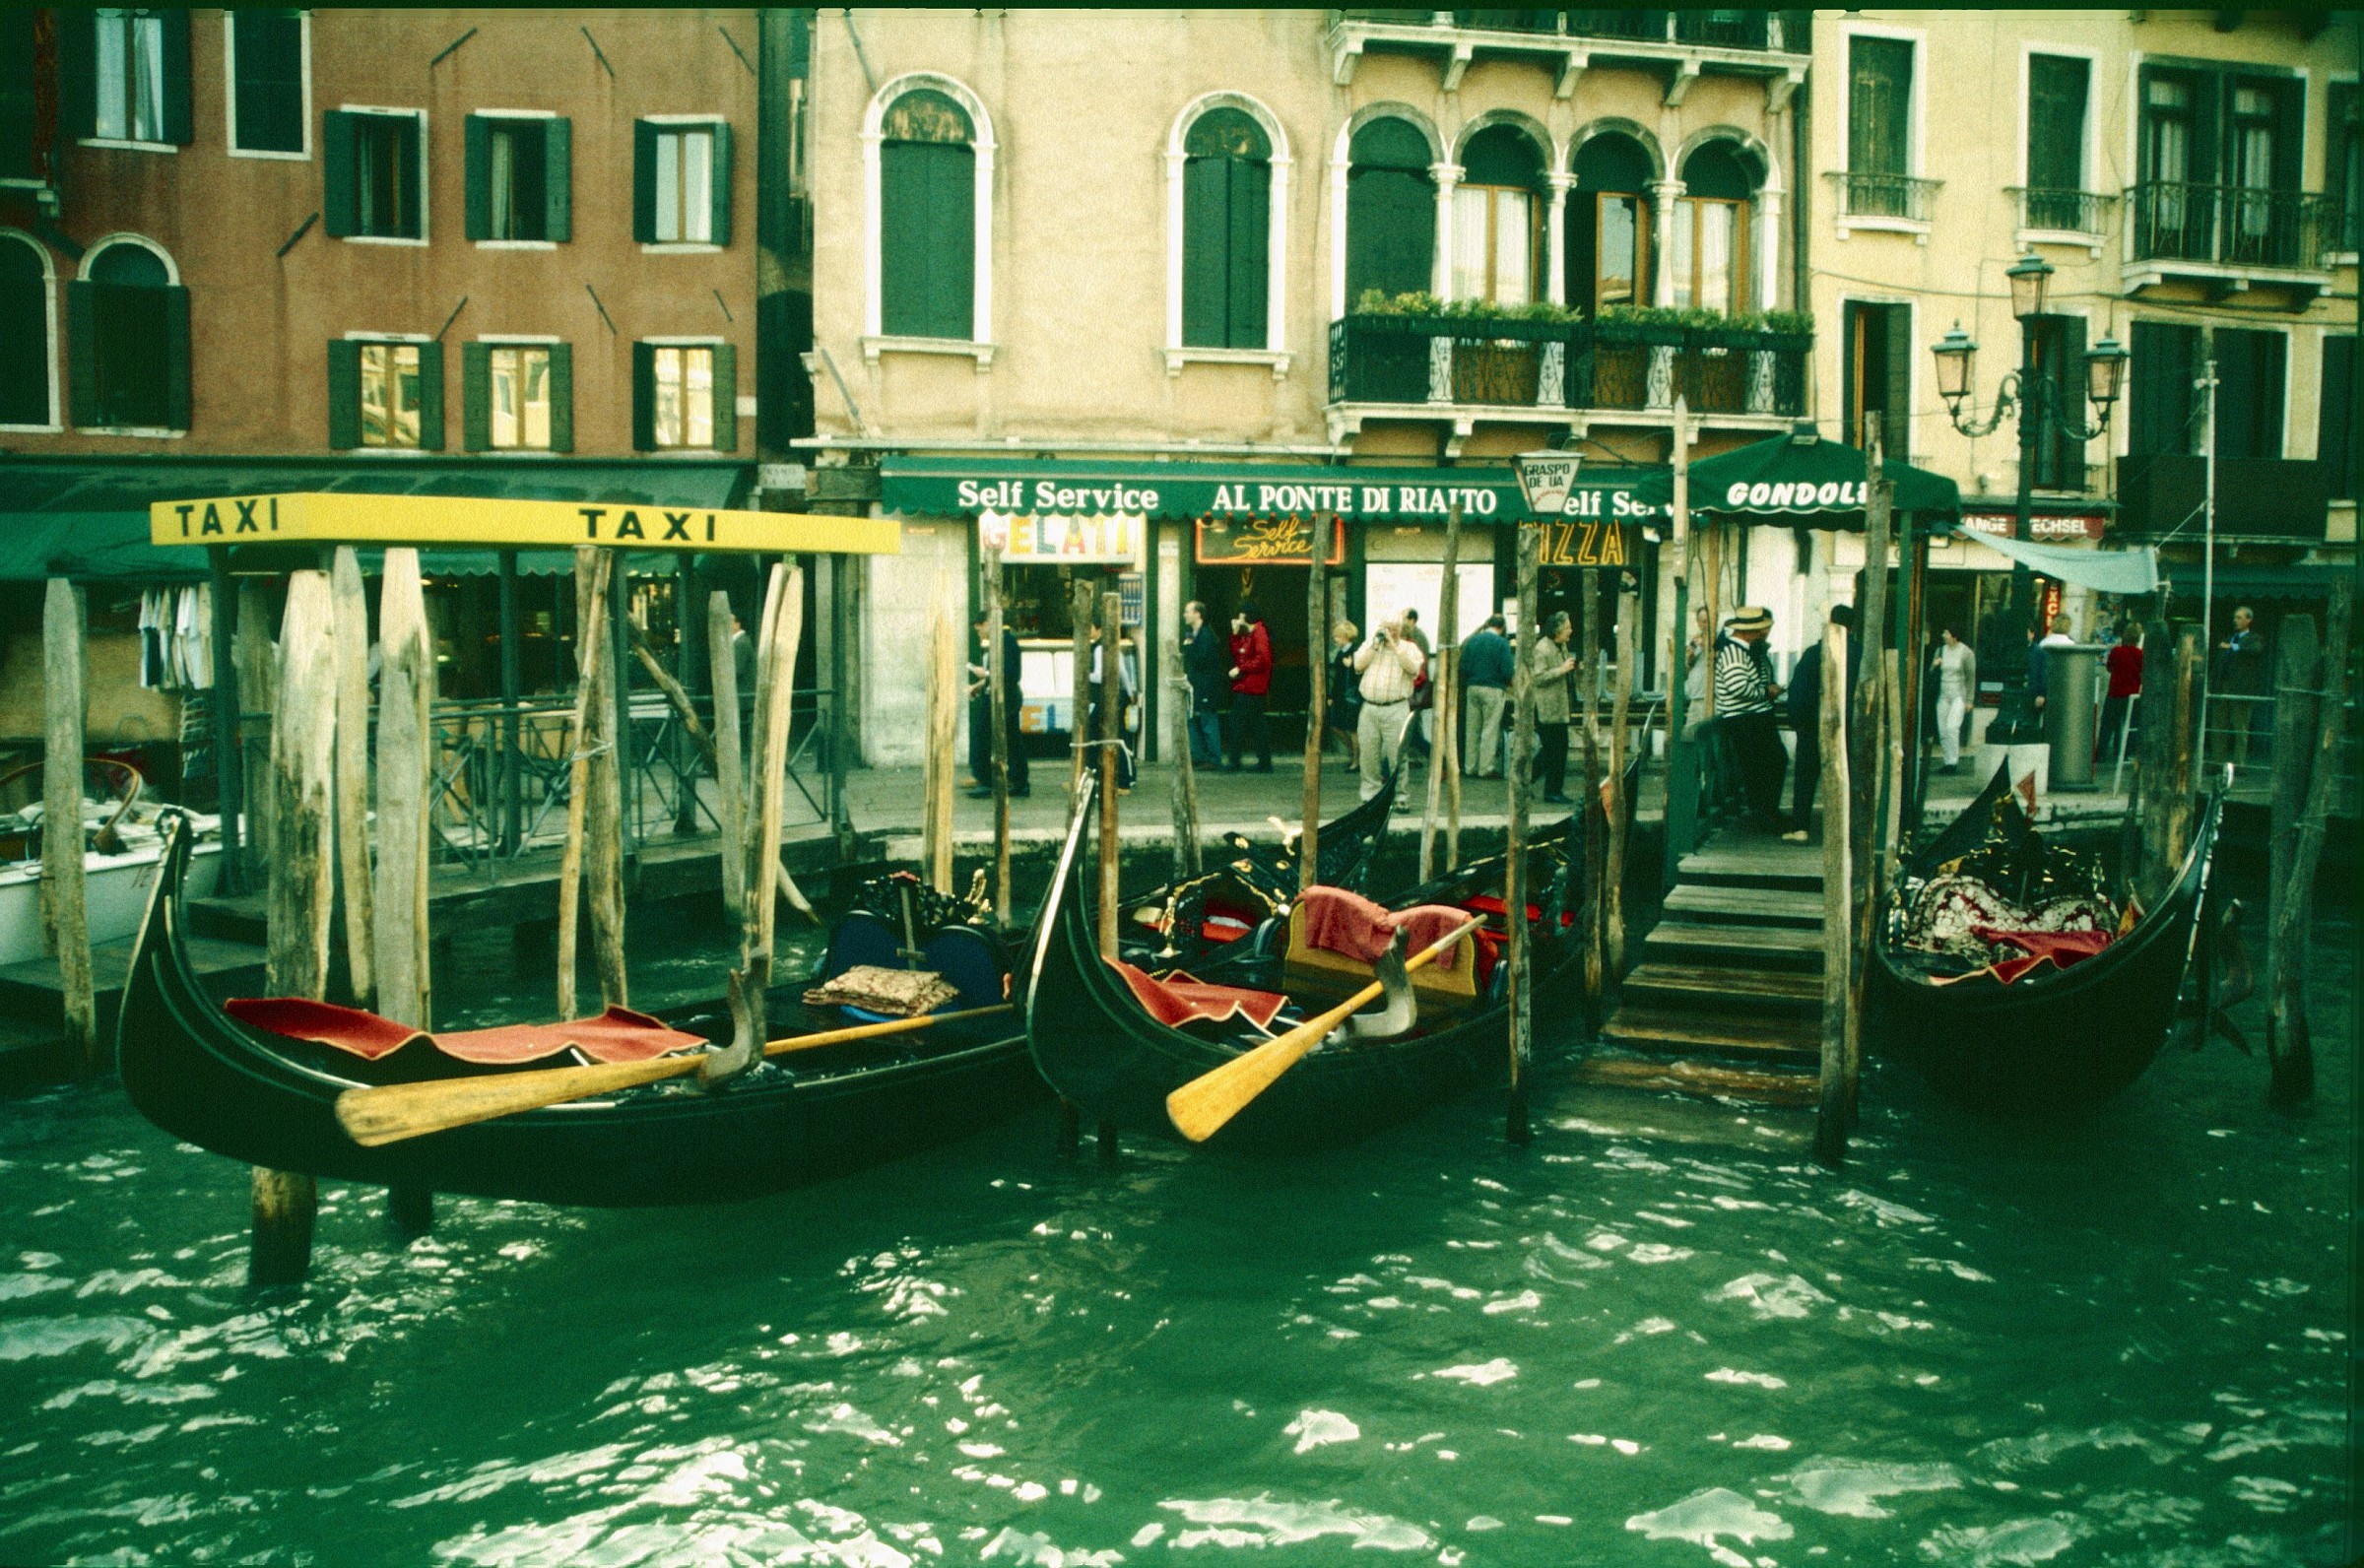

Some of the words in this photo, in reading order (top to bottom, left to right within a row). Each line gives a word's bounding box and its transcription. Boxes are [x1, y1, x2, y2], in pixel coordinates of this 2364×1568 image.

[1524, 463, 1570, 476] GRASPO
[957, 481, 1022, 508] Self
[1036, 482, 1159, 510] Service
[1530, 477, 1543, 489] DE
[1213, 485, 1250, 511] AL
[1259, 486, 1352, 513] PONTE
[1362, 488, 1391, 512] DI
[1399, 487, 1496, 514] RIALTO
[1563, 490, 1602, 516] elf
[175, 497, 279, 537] TAXI
[578, 509, 715, 541] TAXI
[1242, 517, 1298, 542] Self
[1964, 517, 2007, 532] ANGE
[2030, 518, 2088, 534] ECHSEL
[983, 516, 1129, 555] GELATI
[1231, 536, 1313, 559] Service
[1539, 519, 1625, 565] IZZA
